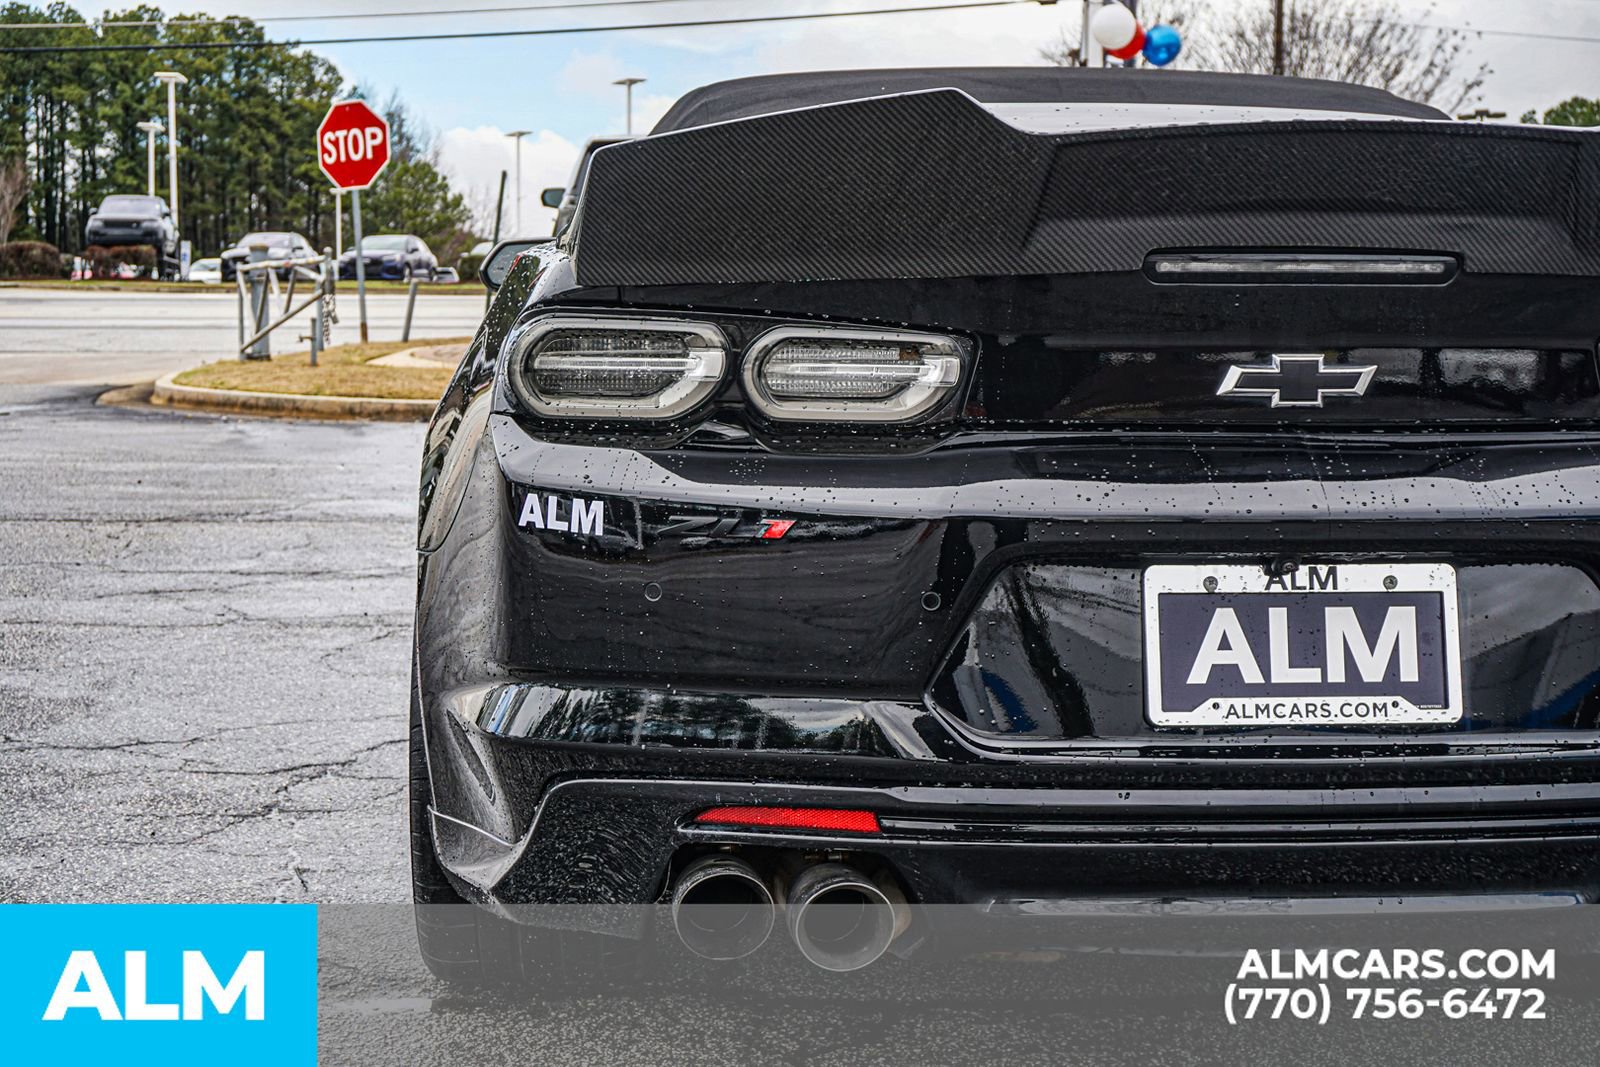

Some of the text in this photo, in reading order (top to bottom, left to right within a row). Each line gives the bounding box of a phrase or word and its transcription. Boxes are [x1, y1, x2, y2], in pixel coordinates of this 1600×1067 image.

[323, 127, 384, 165] STOP
[518, 493, 604, 536] ALM
[1265, 566, 1338, 591] ALM
[1186, 606, 1419, 684] ALM
[1225, 702, 1388, 720] ALMCARS.COM
